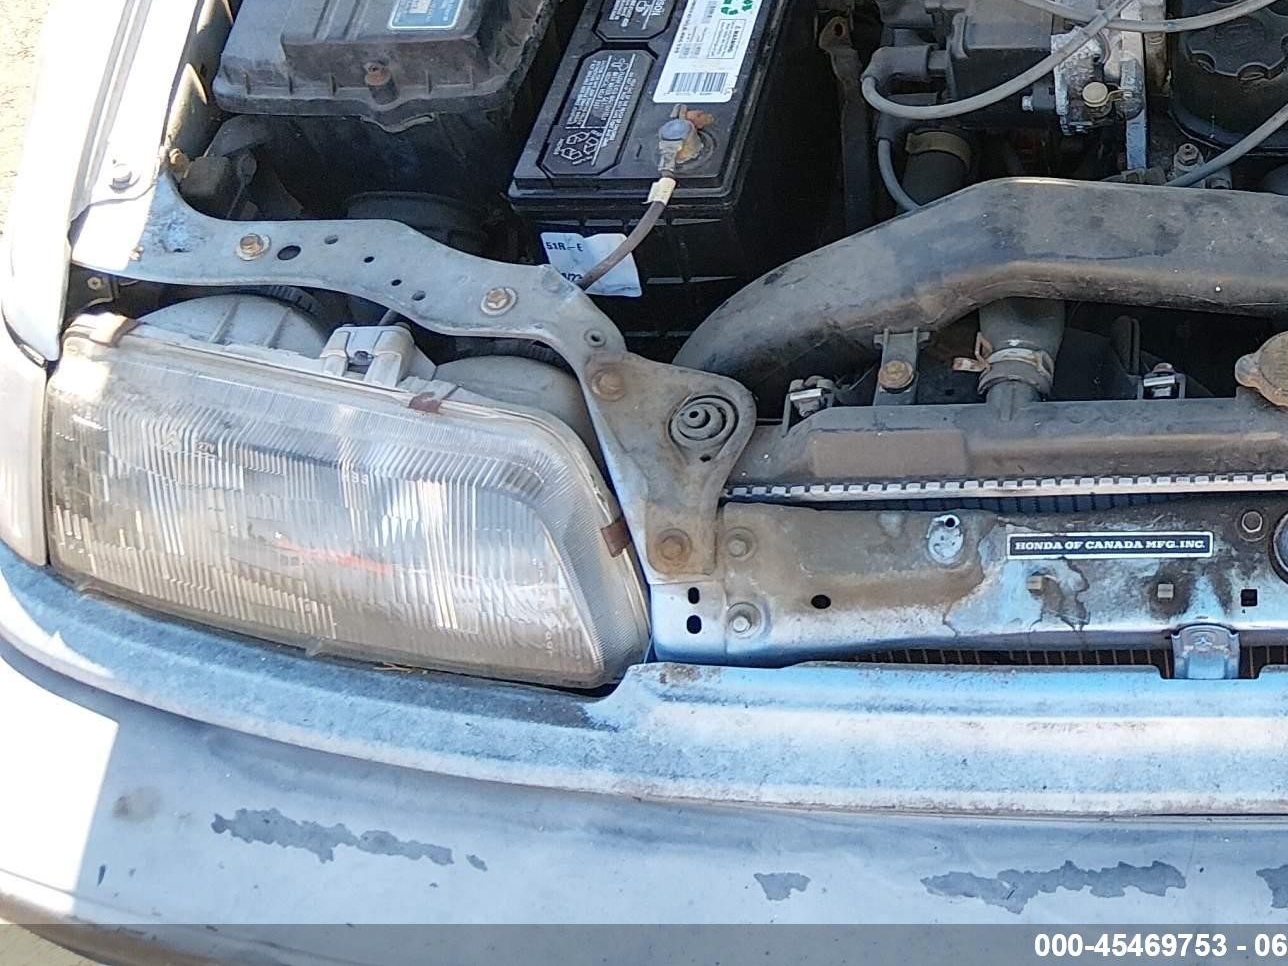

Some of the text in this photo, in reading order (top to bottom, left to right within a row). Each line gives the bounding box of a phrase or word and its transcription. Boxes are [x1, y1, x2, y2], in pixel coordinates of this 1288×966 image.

[1015, 541, 1063, 551] HONDA
[1065, 540, 1083, 550] OF
[1085, 539, 1144, 550] CANADA
